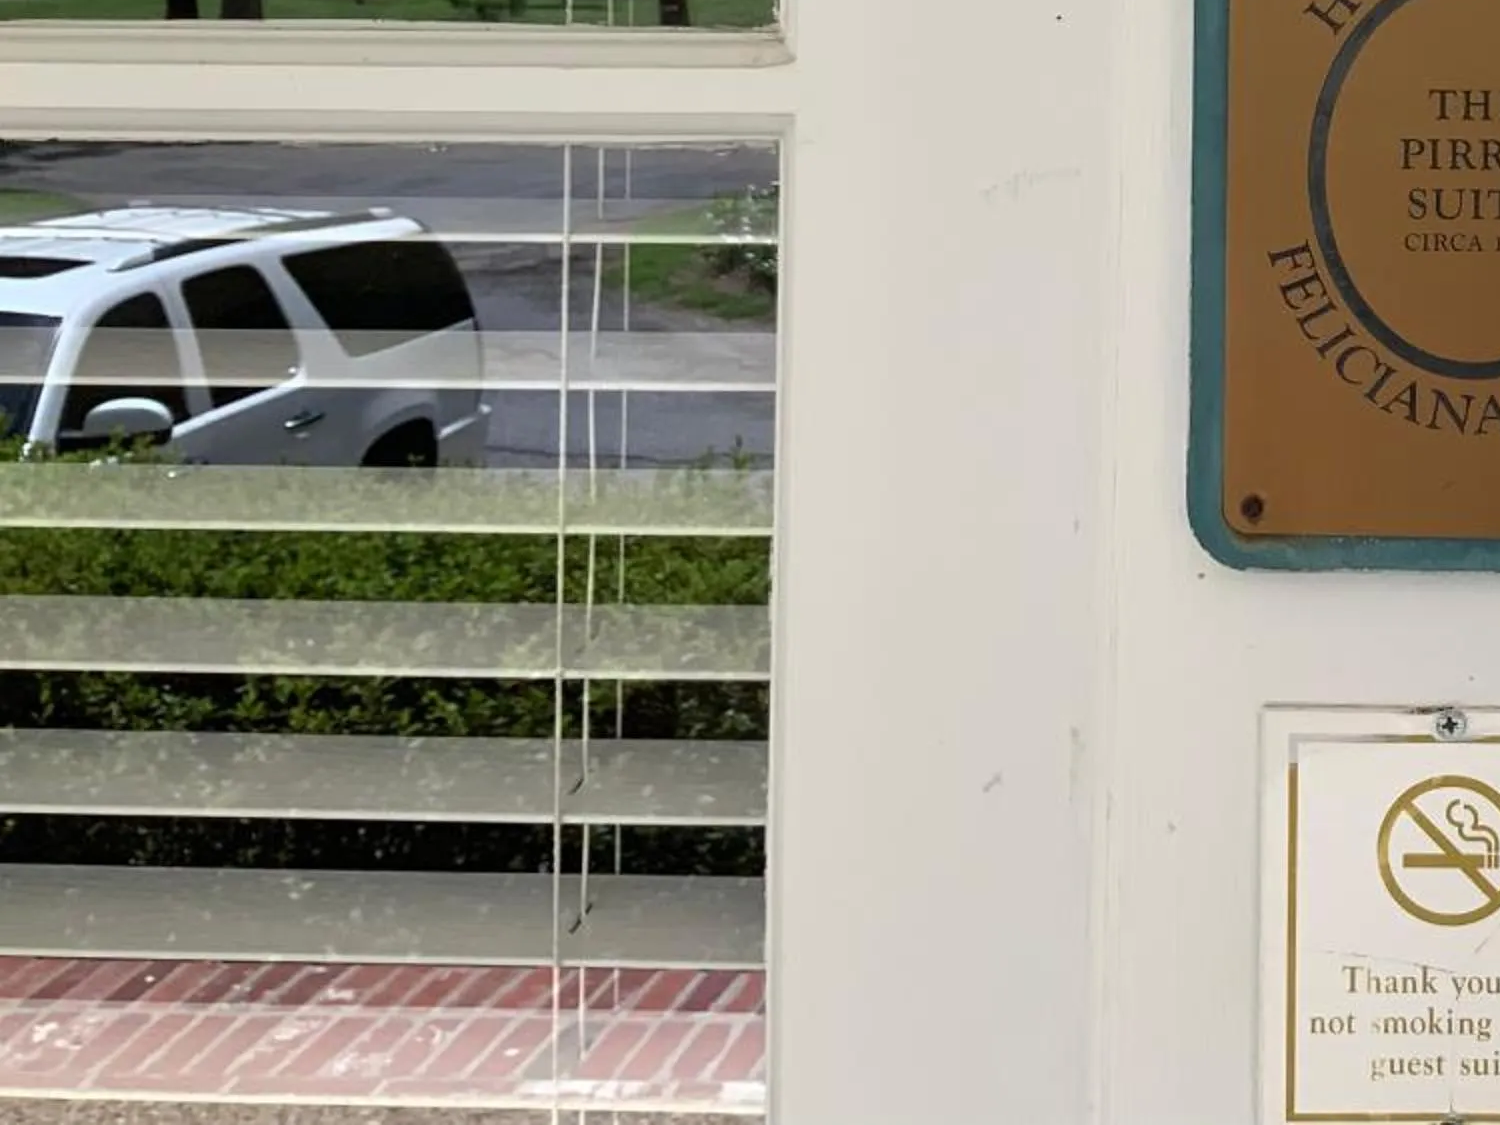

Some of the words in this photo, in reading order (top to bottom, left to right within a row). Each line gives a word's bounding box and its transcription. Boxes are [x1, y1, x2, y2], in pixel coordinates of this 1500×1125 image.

[1404, 234, 1483, 254] CIRCA
[1342, 964, 1438, 995] Thank
[1309, 1012, 1356, 1034] not
[1371, 1007, 1492, 1041] smoking
[1370, 1053, 1445, 1081] guest
